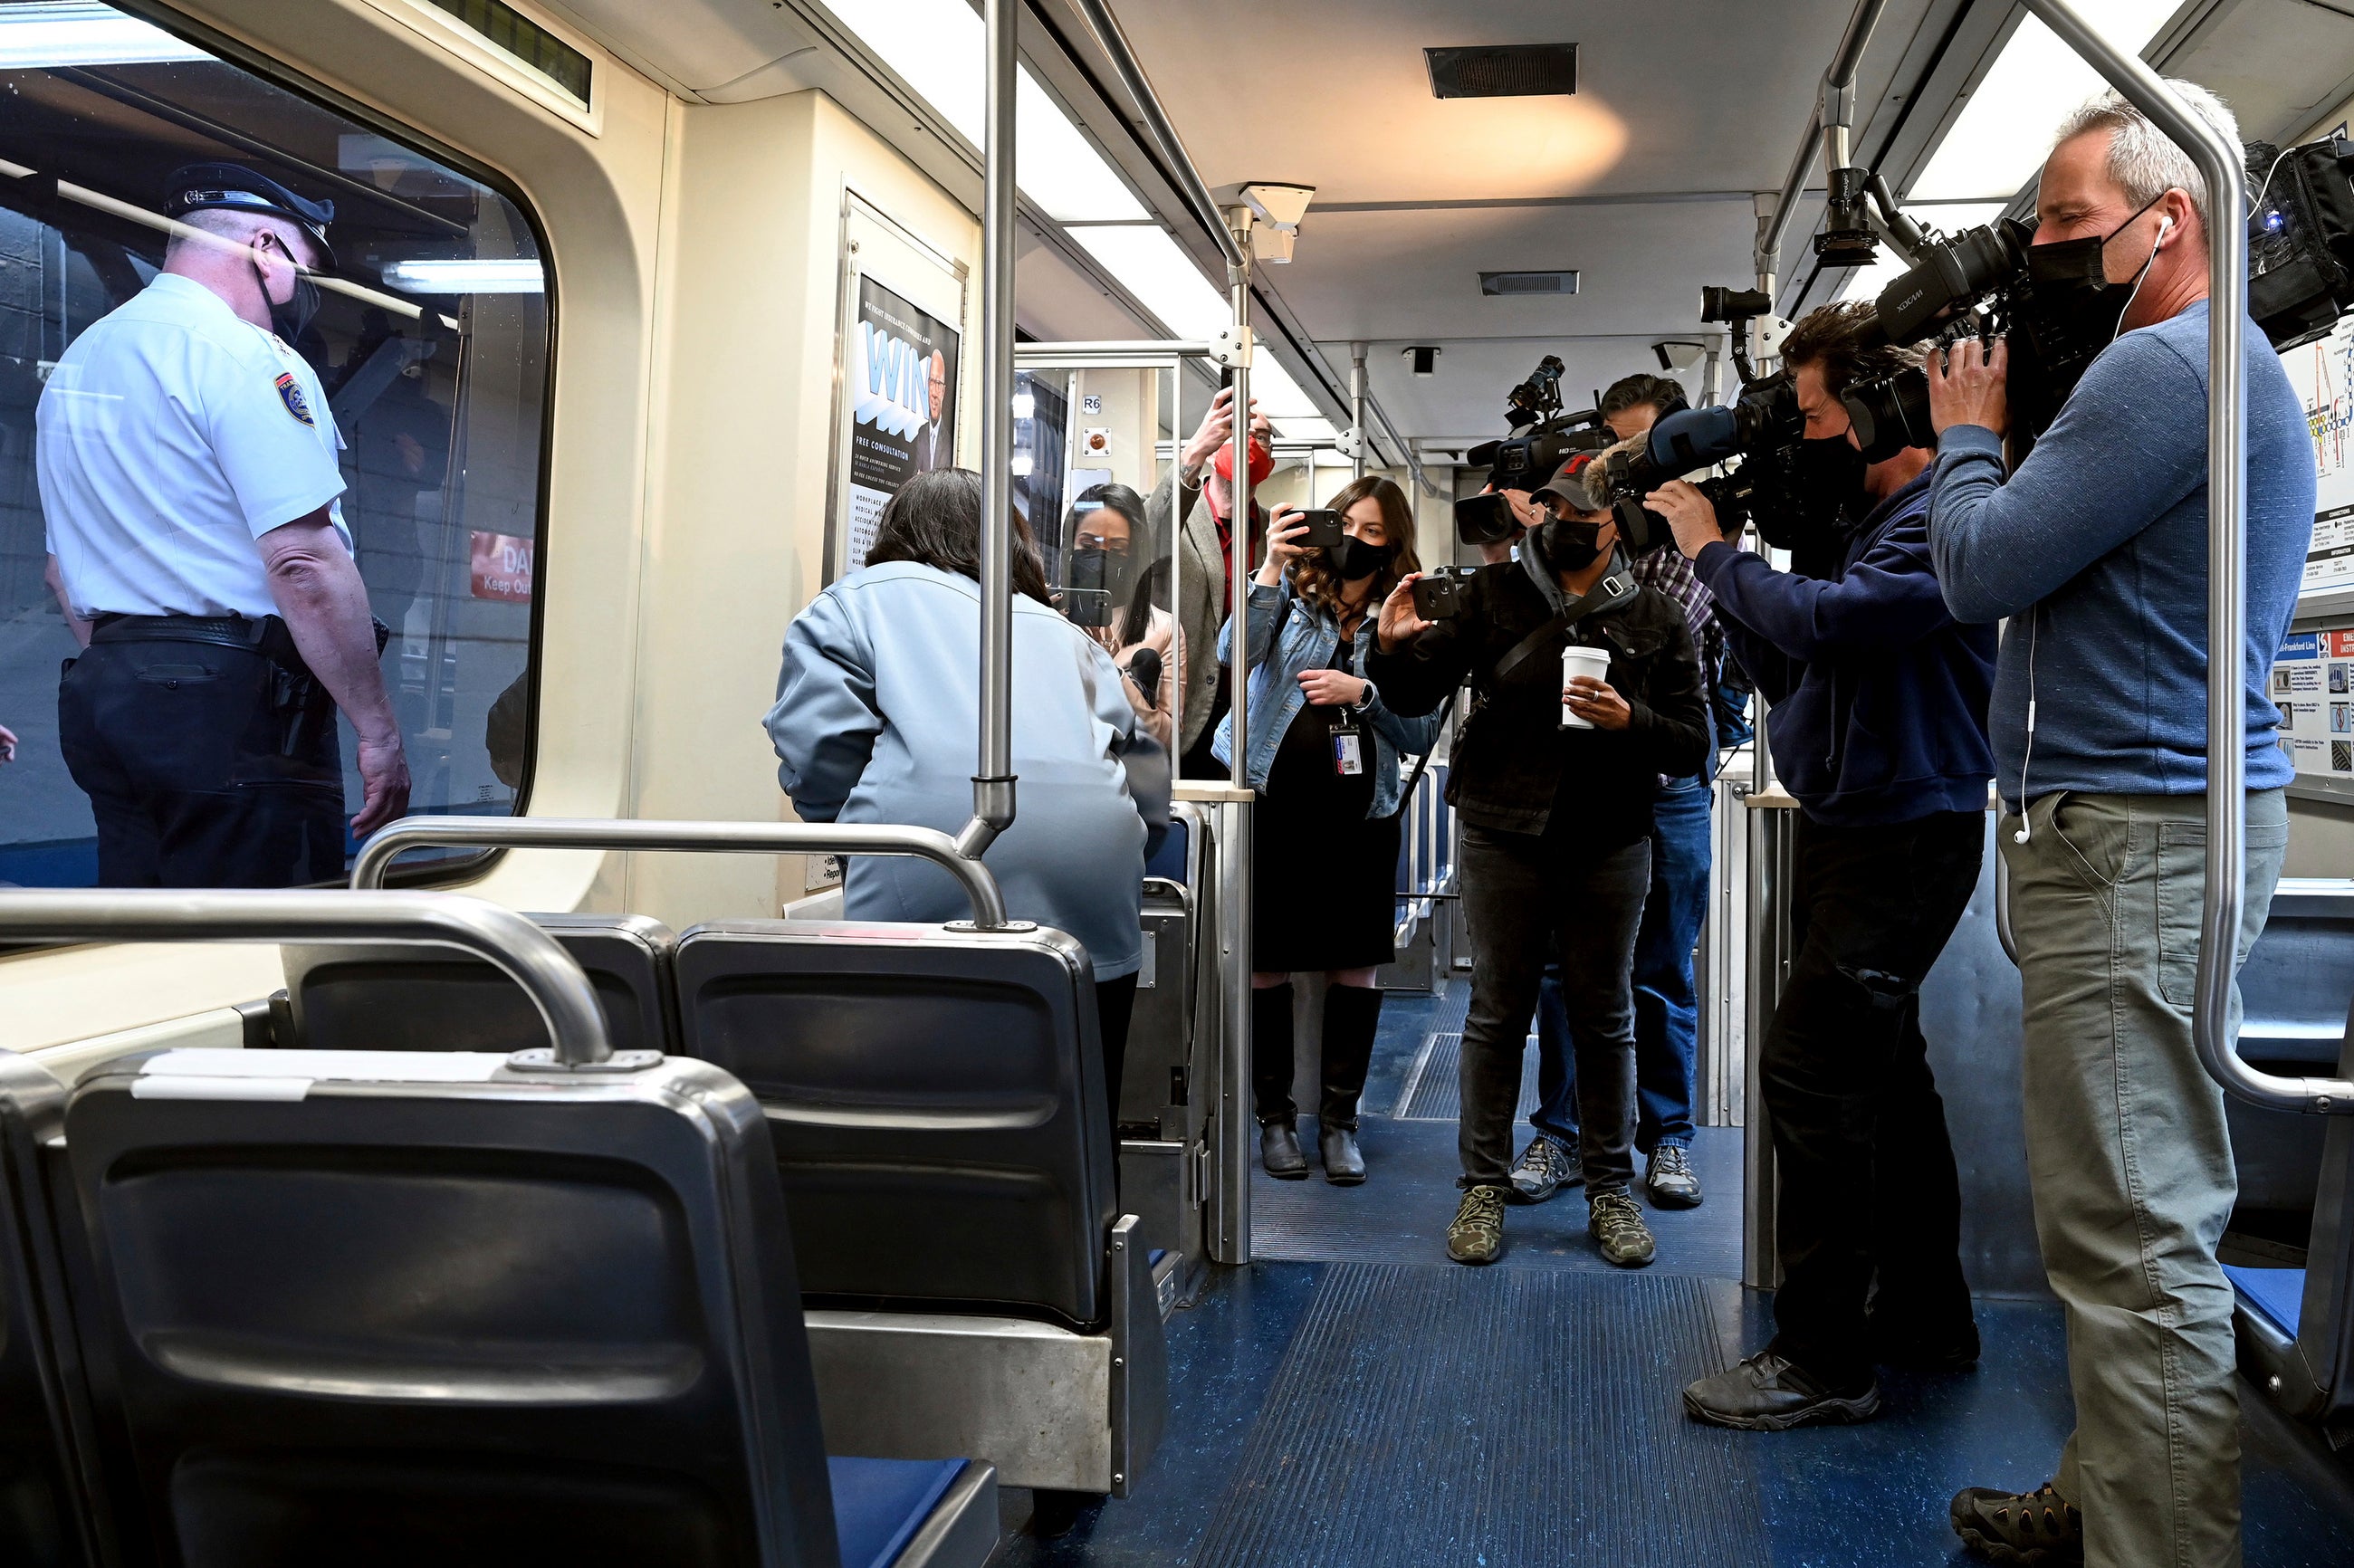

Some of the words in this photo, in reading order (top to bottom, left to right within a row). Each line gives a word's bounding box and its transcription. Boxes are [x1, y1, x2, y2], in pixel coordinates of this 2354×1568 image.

[862, 320, 932, 421] WIN
[1085, 398, 1100, 408] R6
[856, 435, 869, 447] FREE
[871, 440, 909, 462] CONSULTATION
[856, 494, 882, 507] WORKPLACE
[855, 505, 873, 515] MEDICAL
[503, 546, 532, 575] DA
[483, 575, 510, 596] Keep
[514, 578, 531, 595] Out
[2305, 641, 2316, 650] Line
